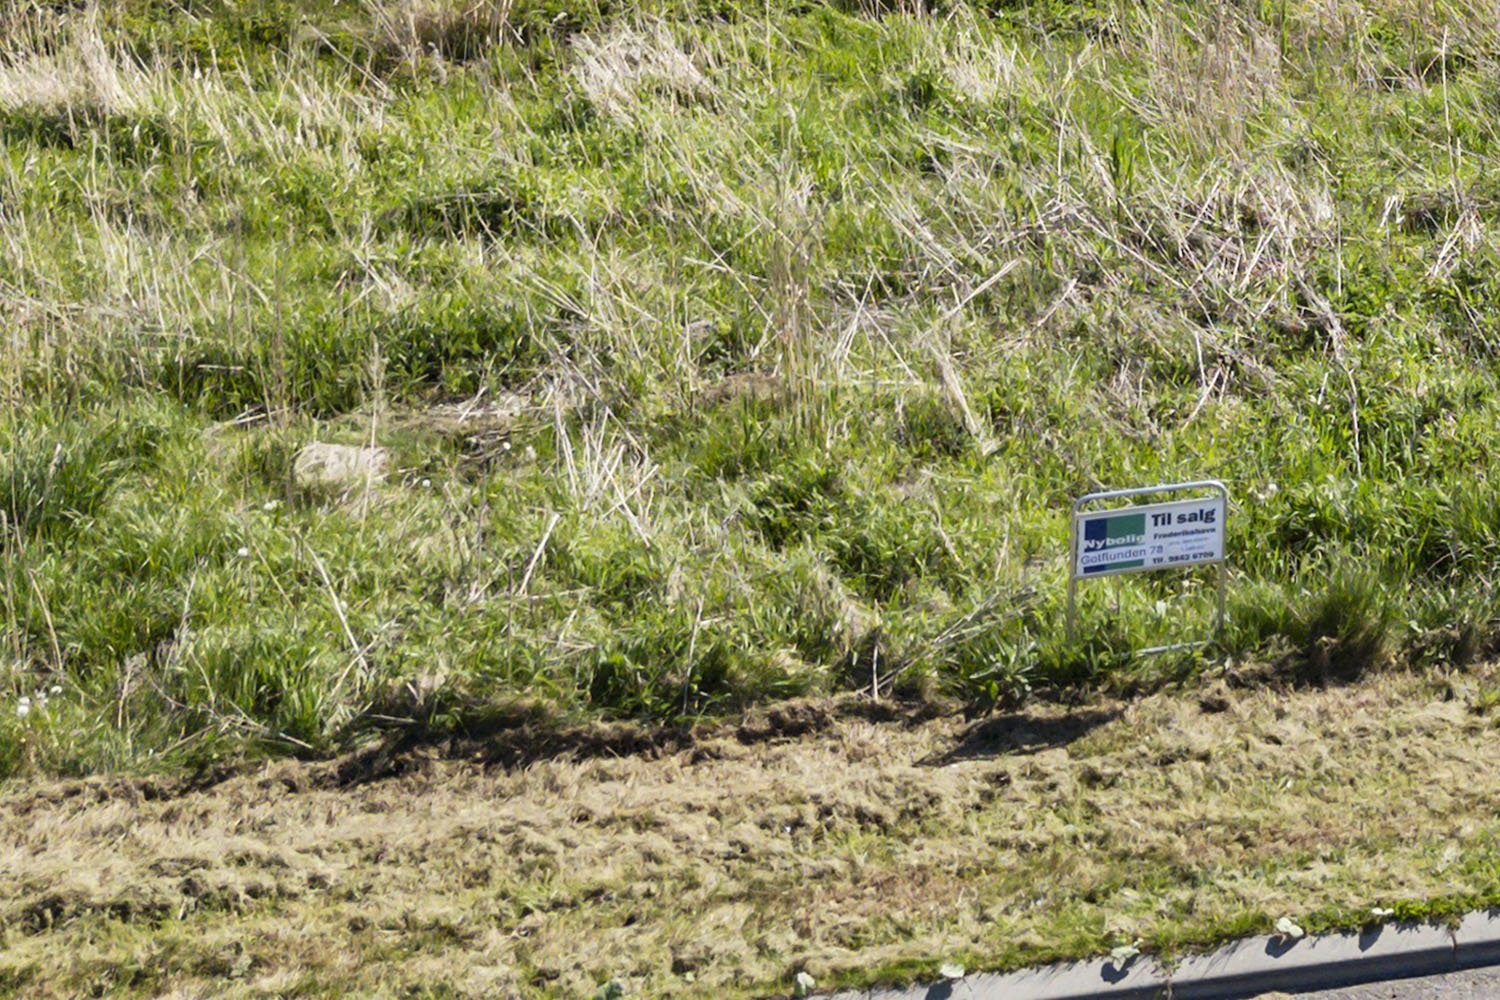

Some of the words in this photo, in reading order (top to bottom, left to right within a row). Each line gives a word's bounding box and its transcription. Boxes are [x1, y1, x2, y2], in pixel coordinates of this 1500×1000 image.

[1152, 512, 1171, 527] Til
[1177, 508, 1216, 524] salg
[1083, 533, 1146, 550] Nybolig
[1081, 548, 1147, 566] Golflunden
